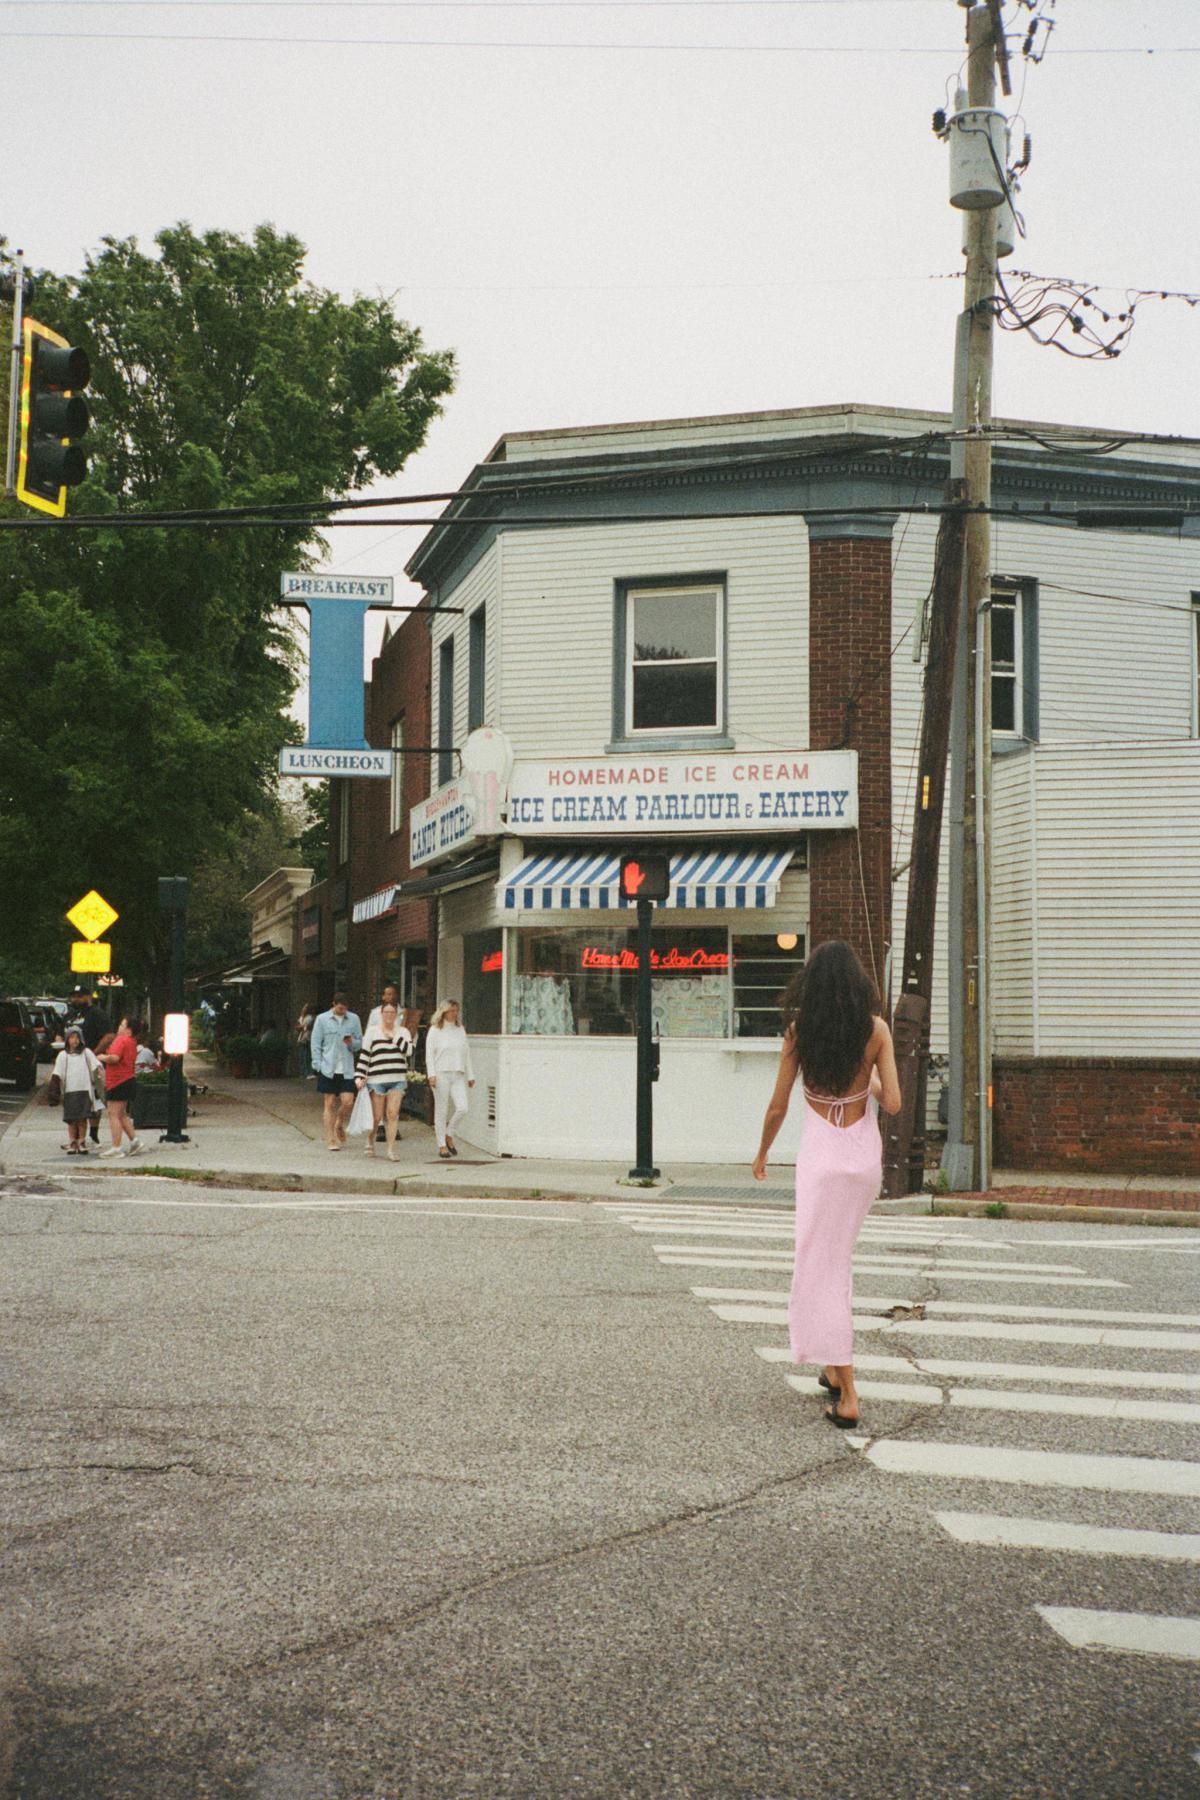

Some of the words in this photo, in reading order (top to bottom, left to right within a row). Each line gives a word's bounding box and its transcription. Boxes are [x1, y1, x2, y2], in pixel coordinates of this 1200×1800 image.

[289, 579, 388, 596] BREAKFAST
[289, 754, 384, 769] LUNCHEON
[549, 767, 669, 786] HOMEMADE
[685, 766, 716, 782] ICE
[732, 763, 809, 781] CREAM
[511, 797, 544, 822] ICE
[552, 795, 627, 822] CREAM
[635, 793, 740, 820] PARLOUR
[745, 803, 754, 818] &
[759, 790, 849, 818] EATERY
[412, 820, 436, 861] CANDY
[583, 948, 619, 965] Home
